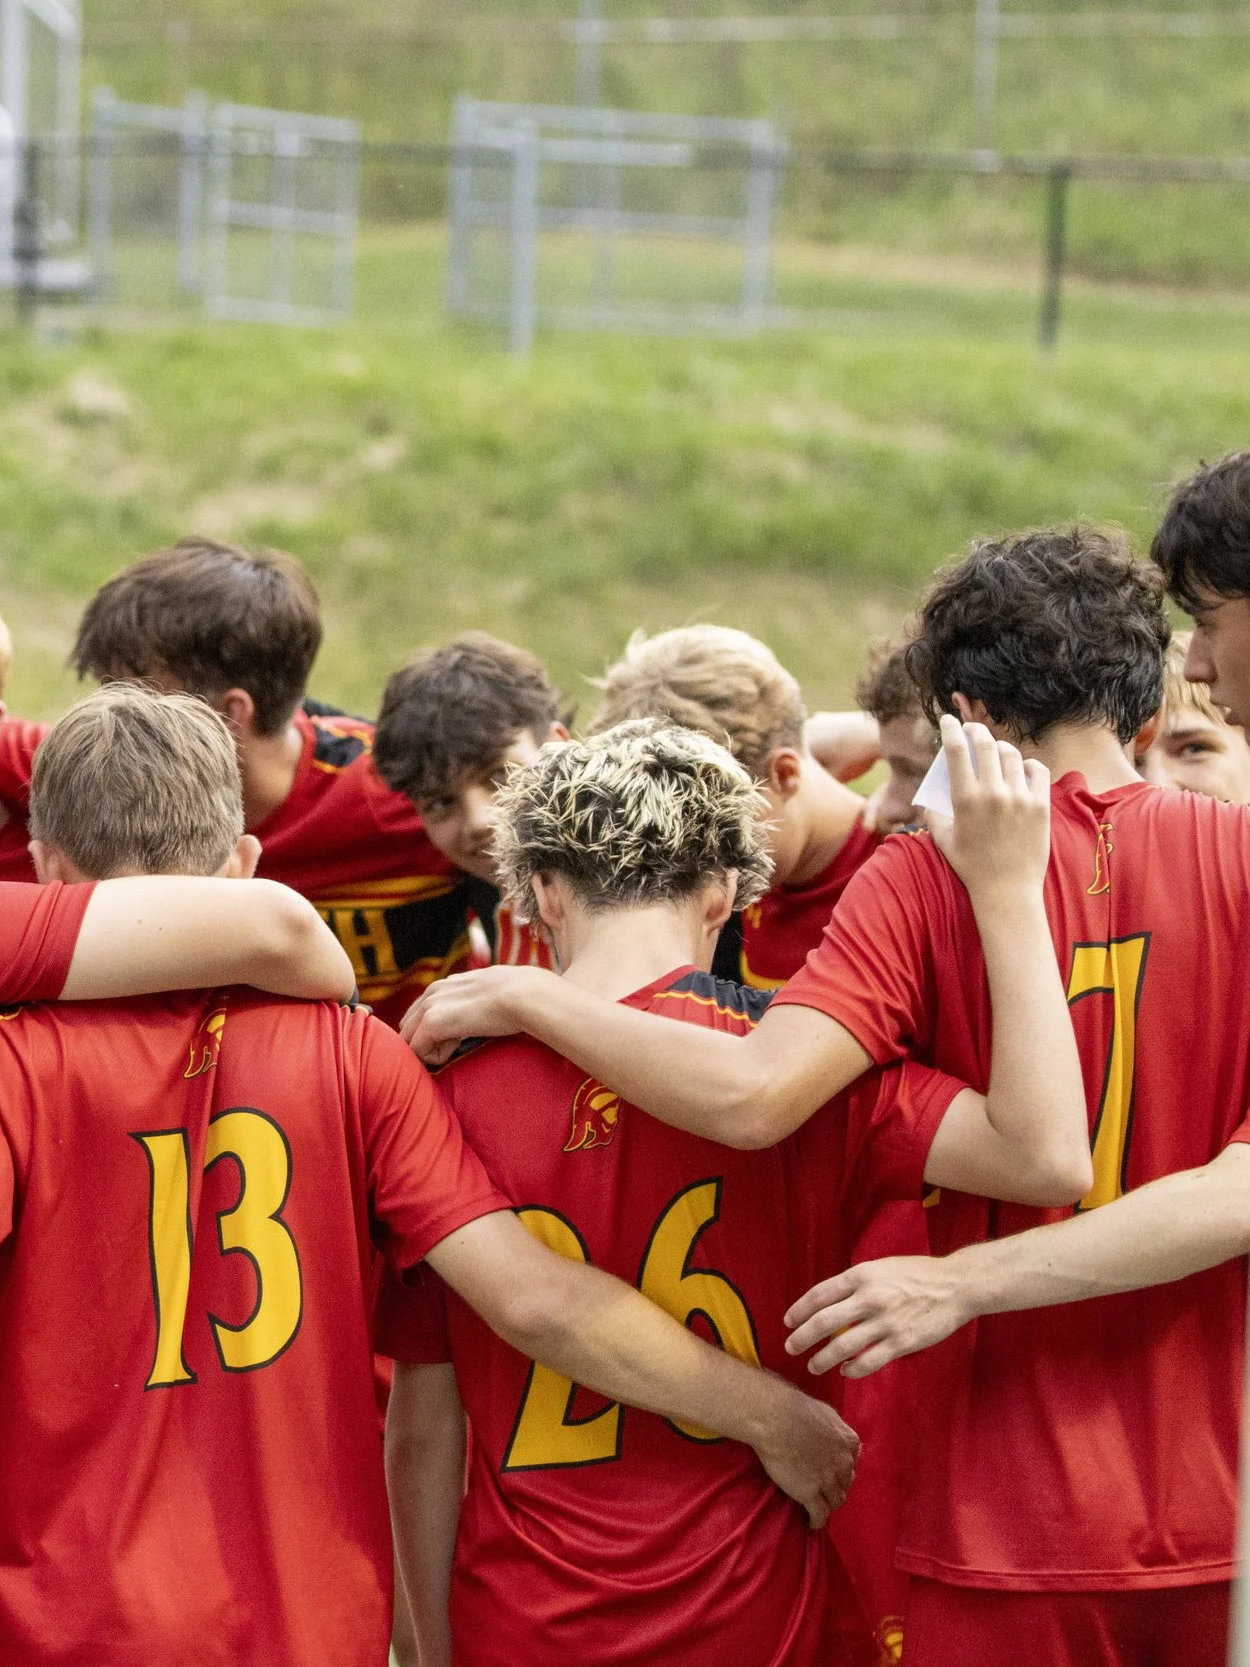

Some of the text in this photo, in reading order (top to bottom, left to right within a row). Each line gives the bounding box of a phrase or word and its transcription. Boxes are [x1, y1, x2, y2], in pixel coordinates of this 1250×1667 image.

[316, 908, 400, 978] H
[1065, 931, 1151, 1213] 7
[127, 1107, 304, 1391] 13
[500, 1176, 763, 1473] 26
